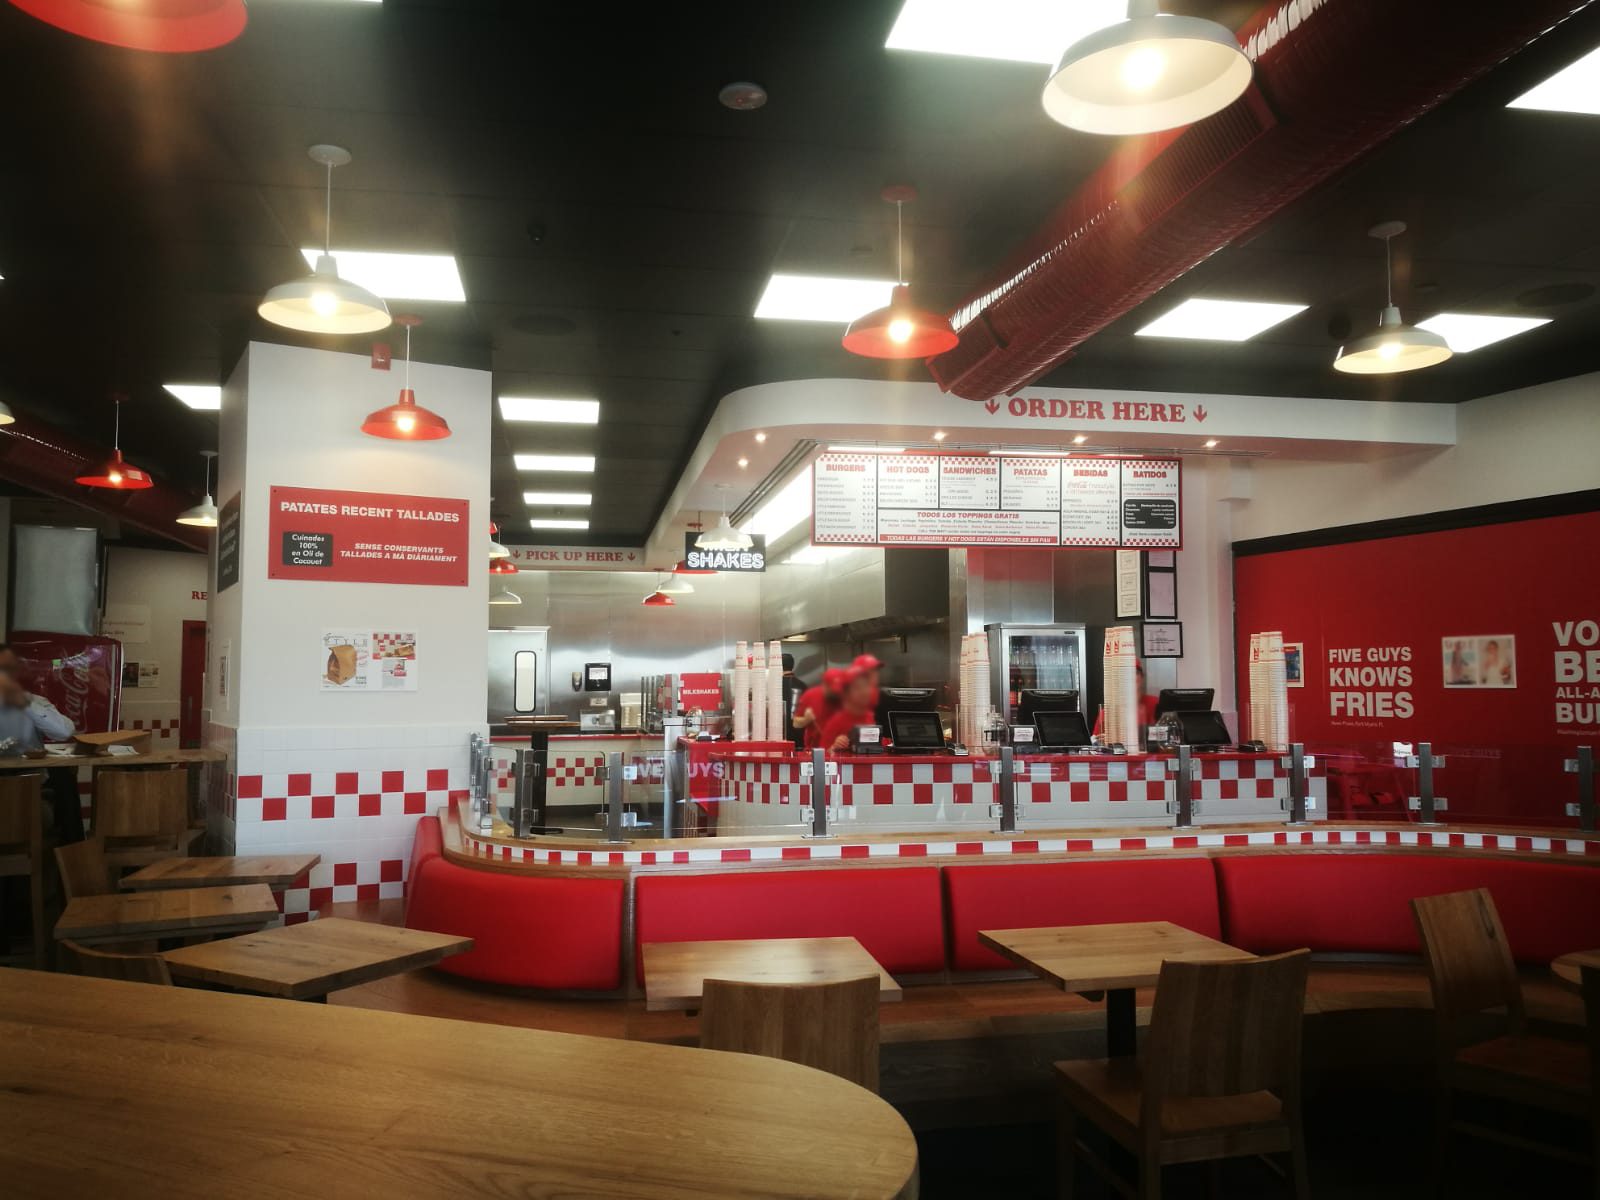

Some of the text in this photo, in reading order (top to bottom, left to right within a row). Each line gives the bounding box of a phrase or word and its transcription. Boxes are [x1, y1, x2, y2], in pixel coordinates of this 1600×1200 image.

[1008, 398, 1186, 423] ORDER HERE
[826, 464, 866, 472] BURGERS
[887, 466, 930, 474] HOT DOGS
[943, 466, 997, 475] SANDWICHES
[1013, 468, 1048, 476] PATATAS
[1073, 469, 1108, 477] BEBIDAS
[1133, 470, 1167, 478] BATIDOS
[281, 501, 460, 523] PATATES RECENT TALLADES
[291, 534, 325, 542] Cuinades
[354, 543, 444, 554] SENSE CONSERVANTS
[340, 550, 383, 559] TALLADES
[525, 550, 623, 561] PICK UP HERE
[687, 551, 765, 569] SHAKES
[191, 591, 208, 600] RE
[1328, 646, 1412, 663] FIVE GUYS
[1329, 665, 1413, 687] KNOWS
[1330, 691, 1414, 719] FRIES
[1555, 702, 1600, 724] BU
[688, 761, 725, 779] UYS
